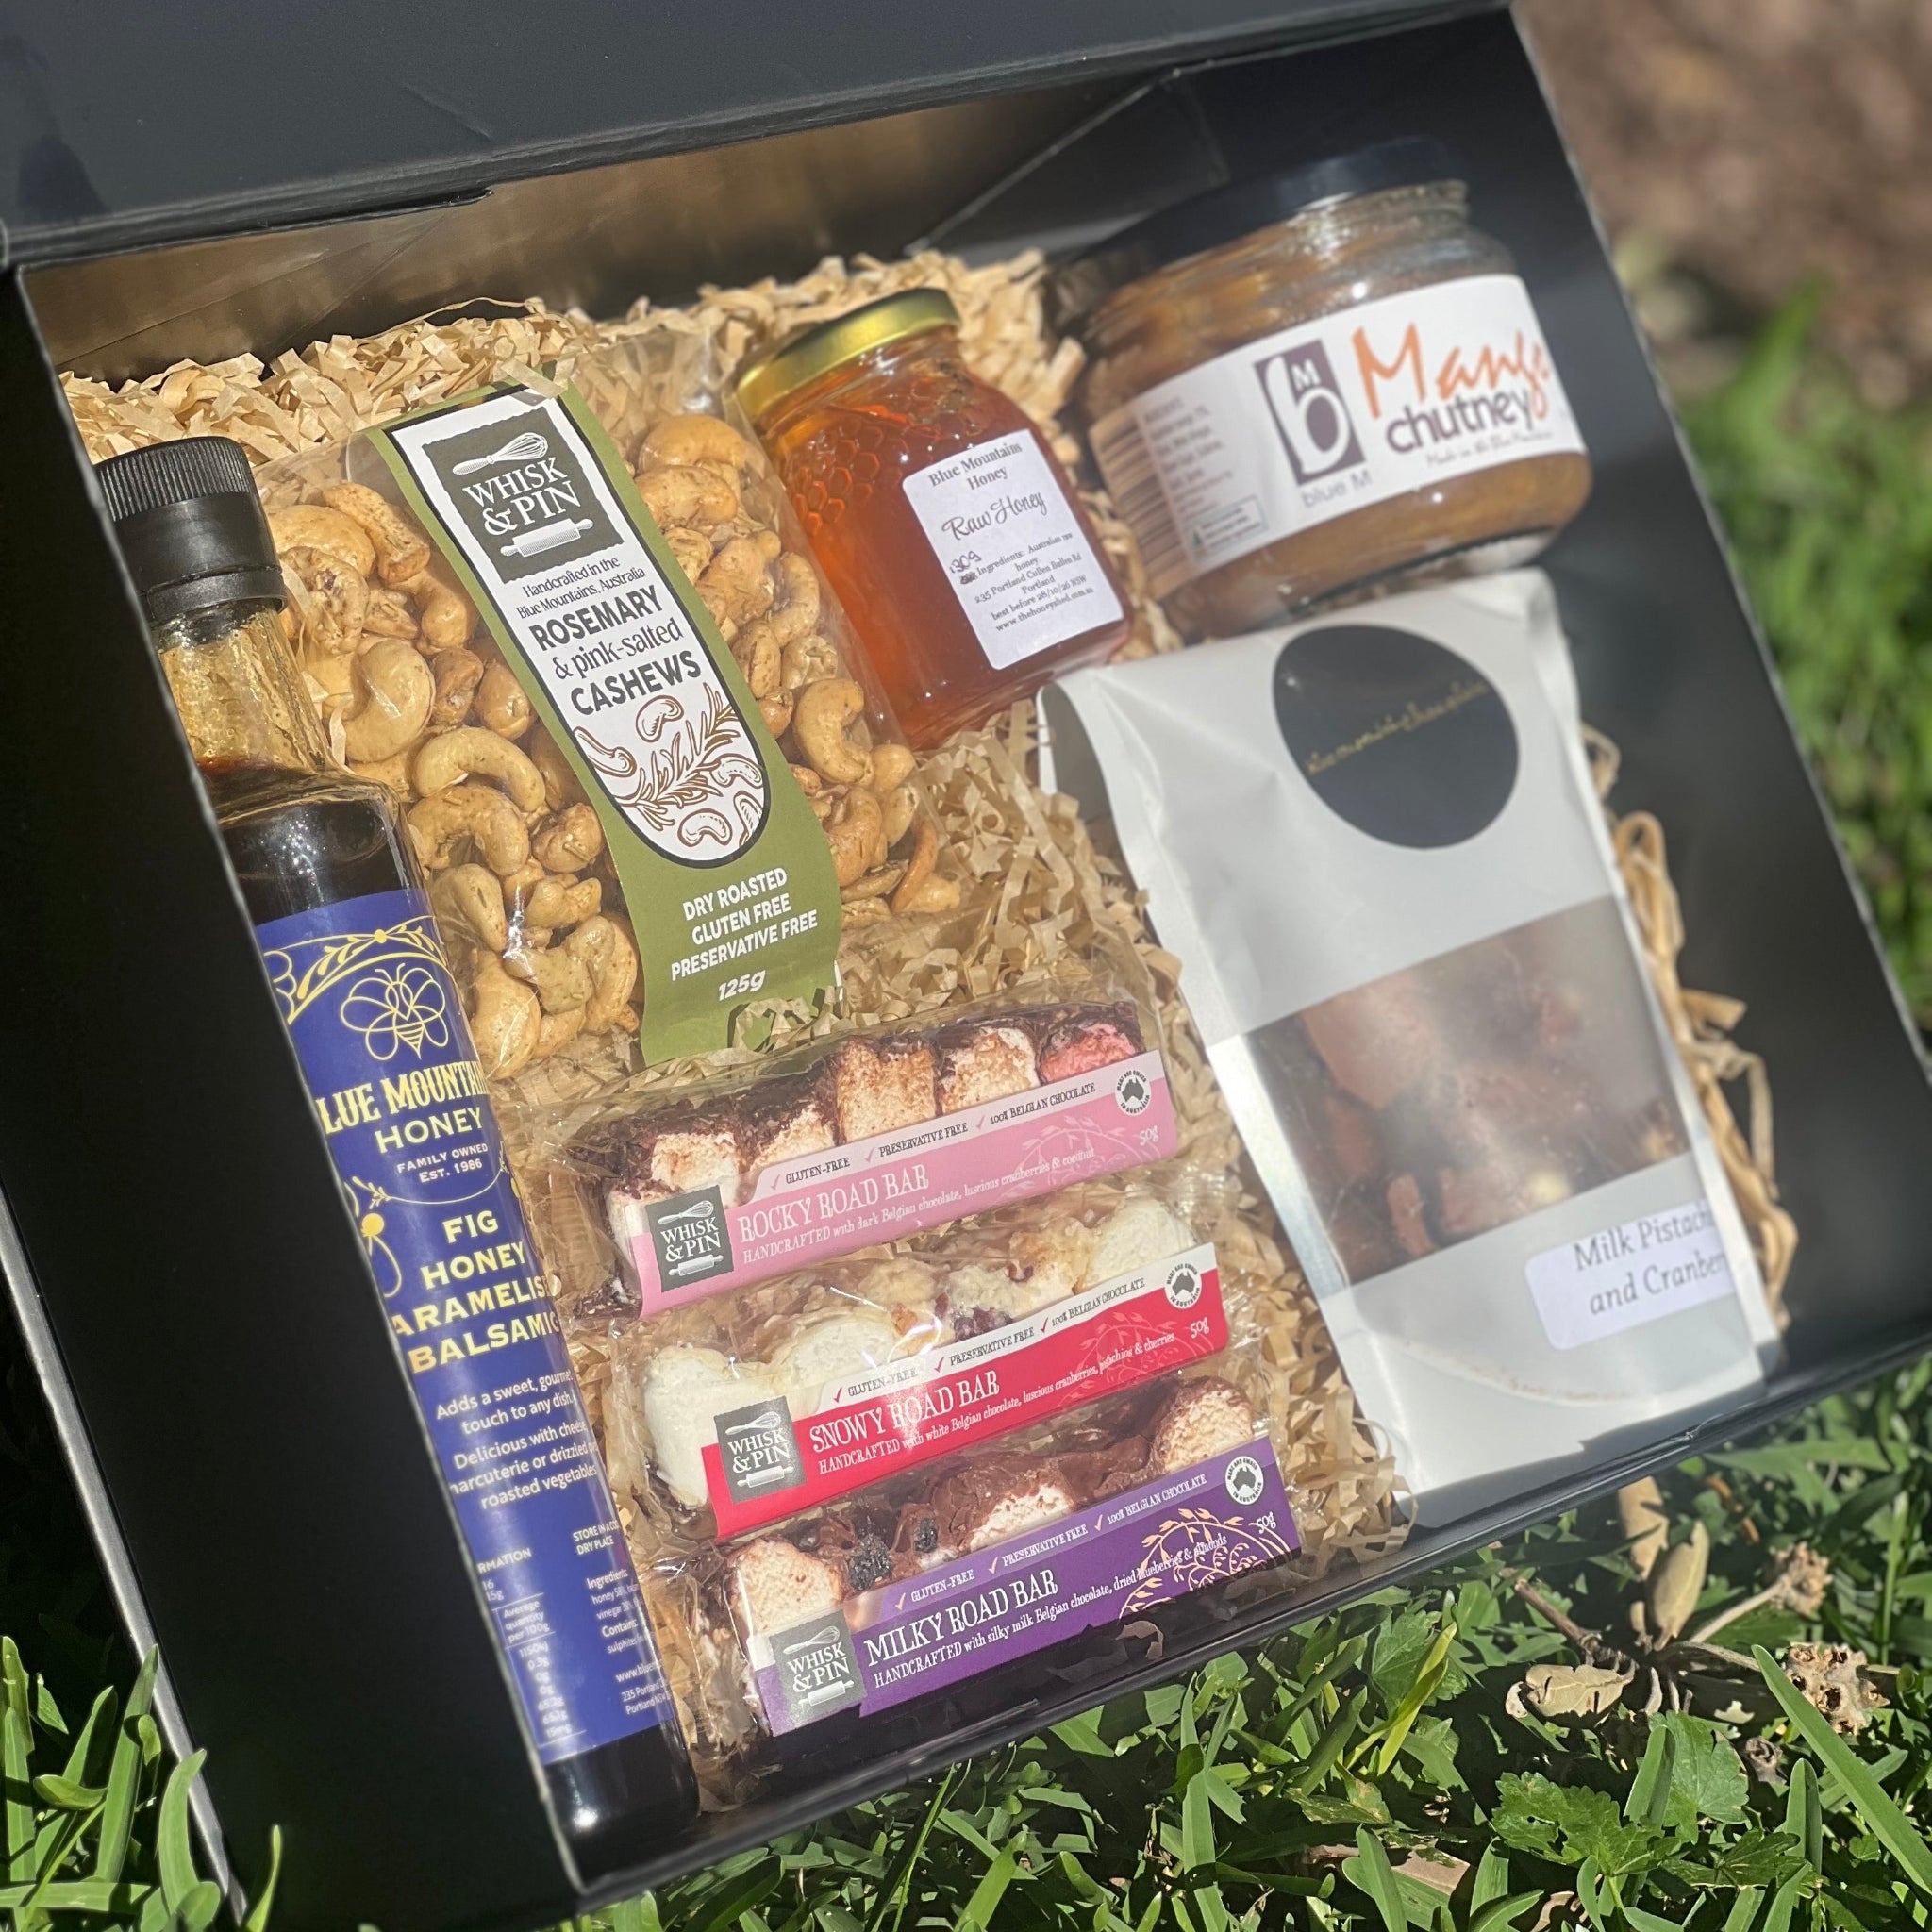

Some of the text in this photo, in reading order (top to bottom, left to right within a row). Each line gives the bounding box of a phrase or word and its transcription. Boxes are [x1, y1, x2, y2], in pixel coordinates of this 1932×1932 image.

[1386, 385, 1534, 454] chutney
[462, 457, 568, 508] WHISK
[928, 442, 1024, 488] Blue Mountains
[967, 466, 1008, 491] Honey
[1301, 469, 1373, 508] blue M
[941, 491, 1048, 541] Raw Honey
[1027, 537, 1062, 555] Australian
[516, 567, 647, 619] Blue Mountains, Australia
[523, 557, 621, 598] Handcrafted in the
[974, 591, 992, 604] 235
[991, 573, 1027, 596] Portland
[1026, 565, 1052, 580] Cullen
[1050, 557, 1074, 570] Bullen
[1021, 574, 1056, 595] Portland
[528, 584, 663, 652] ROSEMARY
[991, 608, 1010, 621] best
[1009, 596, 1037, 612] before
[553, 617, 684, 680] & pink-salted
[571, 650, 702, 715] CASHEWS
[682, 867, 788, 921] DRY ROASTED
[691, 892, 791, 945] GLUTEN FREE
[671, 909, 818, 981] PRESERVATIVE FREE
[718, 970, 766, 1001] 125g
[374, 1107, 484, 1154] HONEY
[785, 1157, 851, 1185] GLUTEN-FREE
[878, 1128, 944, 1158] PRESERVATIVE
[943, 1122, 969, 1138] FREE
[990, 1109, 1009, 1124] 100%
[1009, 1097, 1049, 1119] BELGIAN
[1049, 1082, 1097, 1107] CHOCOLATE
[1140, 1124, 1159, 1147] 50g
[397, 1142, 489, 1174] FAMILY OWNED
[418, 1158, 483, 1184] EST. 1986
[737, 1163, 931, 1243] ROCKY ROAD BAR
[742, 1147, 1096, 1265] HANDCRAFTED with dark Belgian chocolate, luscious cranberries & coconut
[441, 1210, 499, 1244] FIG
[659, 1215, 720, 1245] WHISK
[1574, 1227, 1636, 1273] Milk
[420, 1241, 526, 1290] HONEY
[1590, 1272, 1639, 1315] and
[408, 1311, 560, 1374] BALSAMIC
[847, 1367, 918, 1396] GLUTEN-FREE
[948, 1338, 1013, 1367] PRESERVATIVE
[1012, 1326, 1036, 1344] FREE
[1068, 1297, 1103, 1320] BELGIAN
[1102, 1277, 1146, 1305] CHOCOLATE
[1190, 1317, 1209, 1338] 50g
[436, 1368, 574, 1420] Adds a sweet, gourmet
[461, 1409, 509, 1435] touch
[510, 1405, 527, 1420] to
[529, 1397, 552, 1416] any
[809, 1370, 1001, 1453] SNOWY ROAD BAR
[818, 1331, 1175, 1475] HANDCRAFTED with white Belgian chocolate, luscious cranberries, & cherries
[453, 1424, 559, 1471] Delicious with
[531, 1455, 548, 1470] or
[549, 1440, 589, 1464] drizzled
[727, 1426, 788, 1456] WHISK
[480, 1463, 598, 1510] roasted vegetables
[572, 1525, 599, 1542] STORE
[576, 1535, 615, 1555] DRY PLACE
[910, 1569, 975, 1603] GLUTEN-FREE
[1001, 1535, 1067, 1567] PRESERVATIVE
[1066, 1524, 1089, 1542] FREE
[1106, 1509, 1125, 1525] 100%
[1124, 1494, 1163, 1518] BELGIAN
[1161, 1474, 1208, 1502] CHOCOLATE
[1256, 1511, 1276, 1535] 50g
[503, 1601, 541, 1619] Average
[505, 1611, 544, 1631] quantity
[591, 1591, 615, 1605] honey
[596, 1606, 623, 1621] vinegar
[863, 1568, 1058, 1667] MILKY ROAD BAR
[874, 1641, 962, 1689] HANDCRAFTED
[962, 1633, 987, 1653] with
[987, 1622, 1010, 1642] silky
[1011, 1613, 1034, 1634] milk
[1034, 1599, 1070, 1624] Belgian
[1070, 1582, 1113, 1608] chocolate,
[1113, 1568, 1138, 1591] dried
[1183, 1546, 1193, 1560] &
[1192, 1532, 1228, 1557] almonds
[508, 1630, 525, 1643] per
[786, 1641, 846, 1674] WHISK
[621, 1688, 636, 1702] 235
